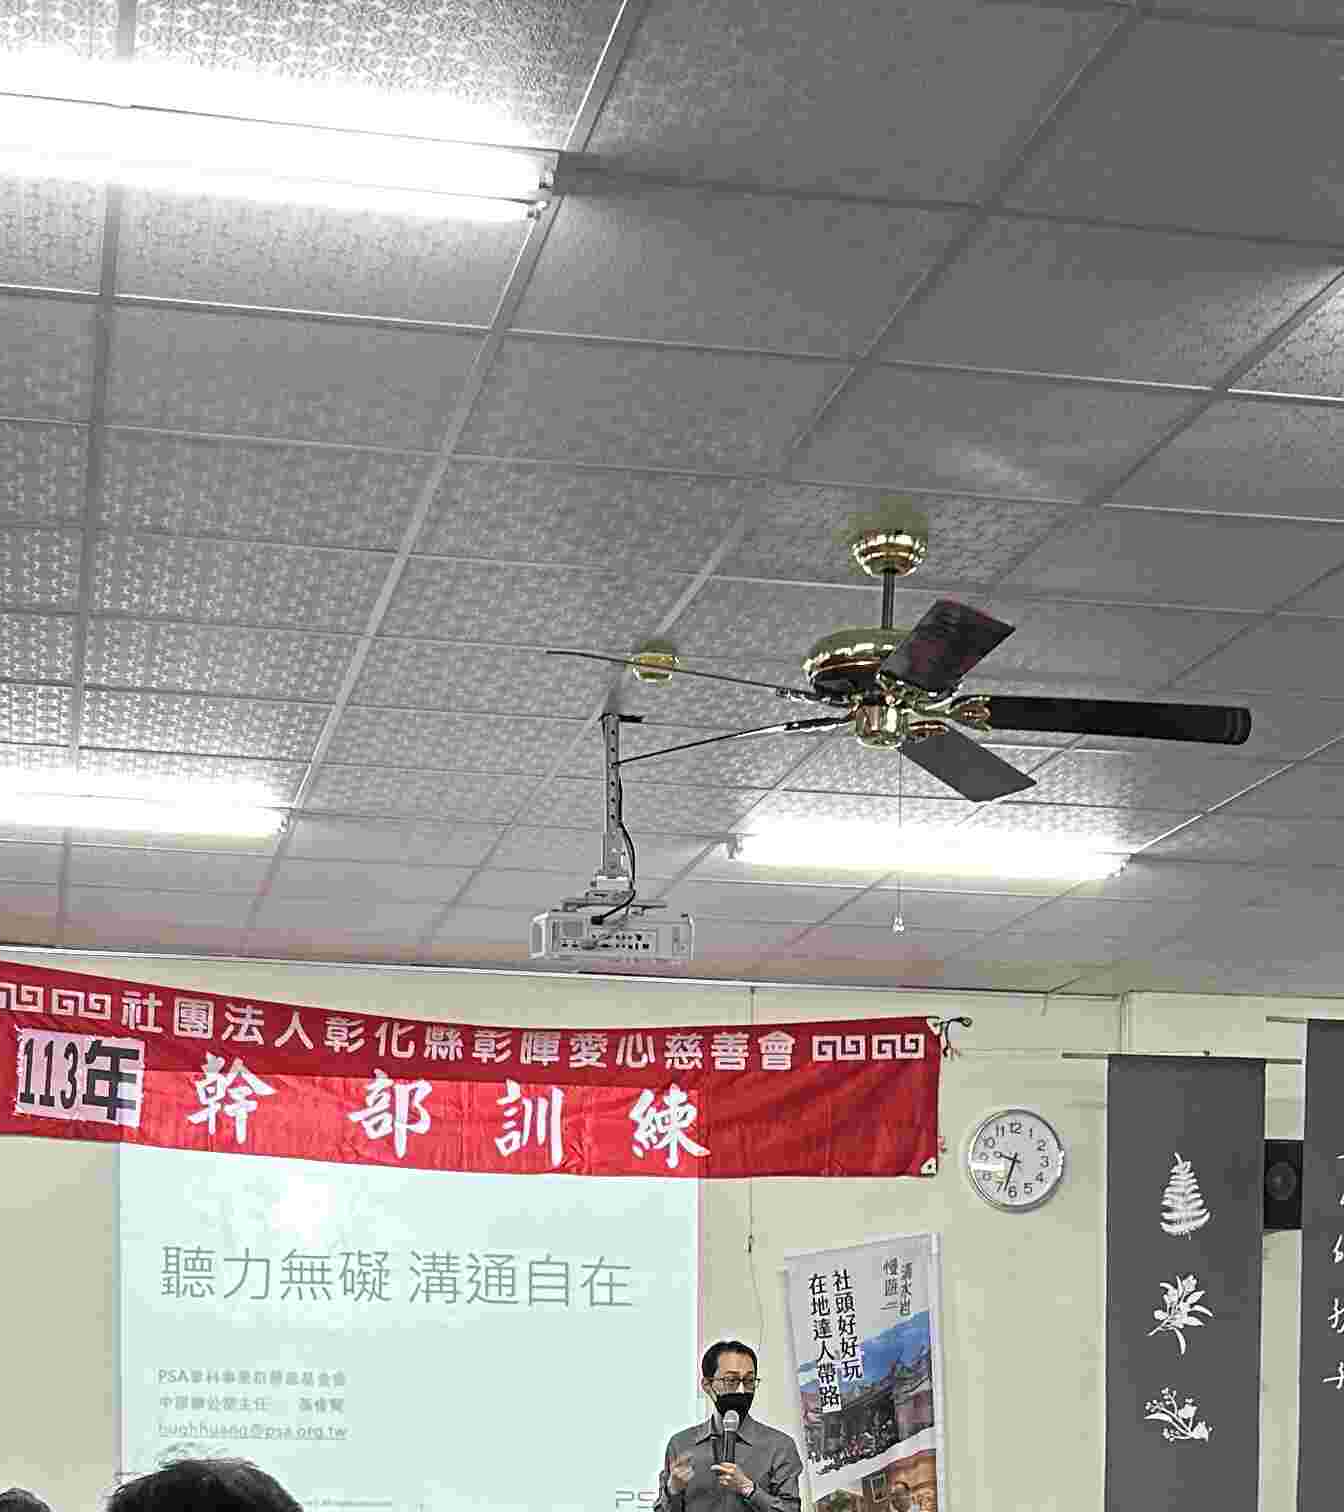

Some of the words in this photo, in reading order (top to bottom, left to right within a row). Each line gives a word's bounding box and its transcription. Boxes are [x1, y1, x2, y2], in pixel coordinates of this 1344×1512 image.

[121, 990, 796, 1073] 社團法人彰化縣彰暉愛心慈善會
[19, 1037, 140, 1121] 113年
[187, 1052, 711, 1169] 幹部訓練
[1010, 1122, 1022, 1134] 12
[1037, 1139, 1047, 1151] 2
[1007, 1185, 1017, 1198] 6
[1023, 1183, 1033, 1194] 5
[160, 1244, 392, 1304] 聽力無礙
[407, 1251, 634, 1309] 溝通自在
[808, 1273, 841, 1409] 在地達人帶路
[832, 1268, 864, 1379] 社頭好好玩
